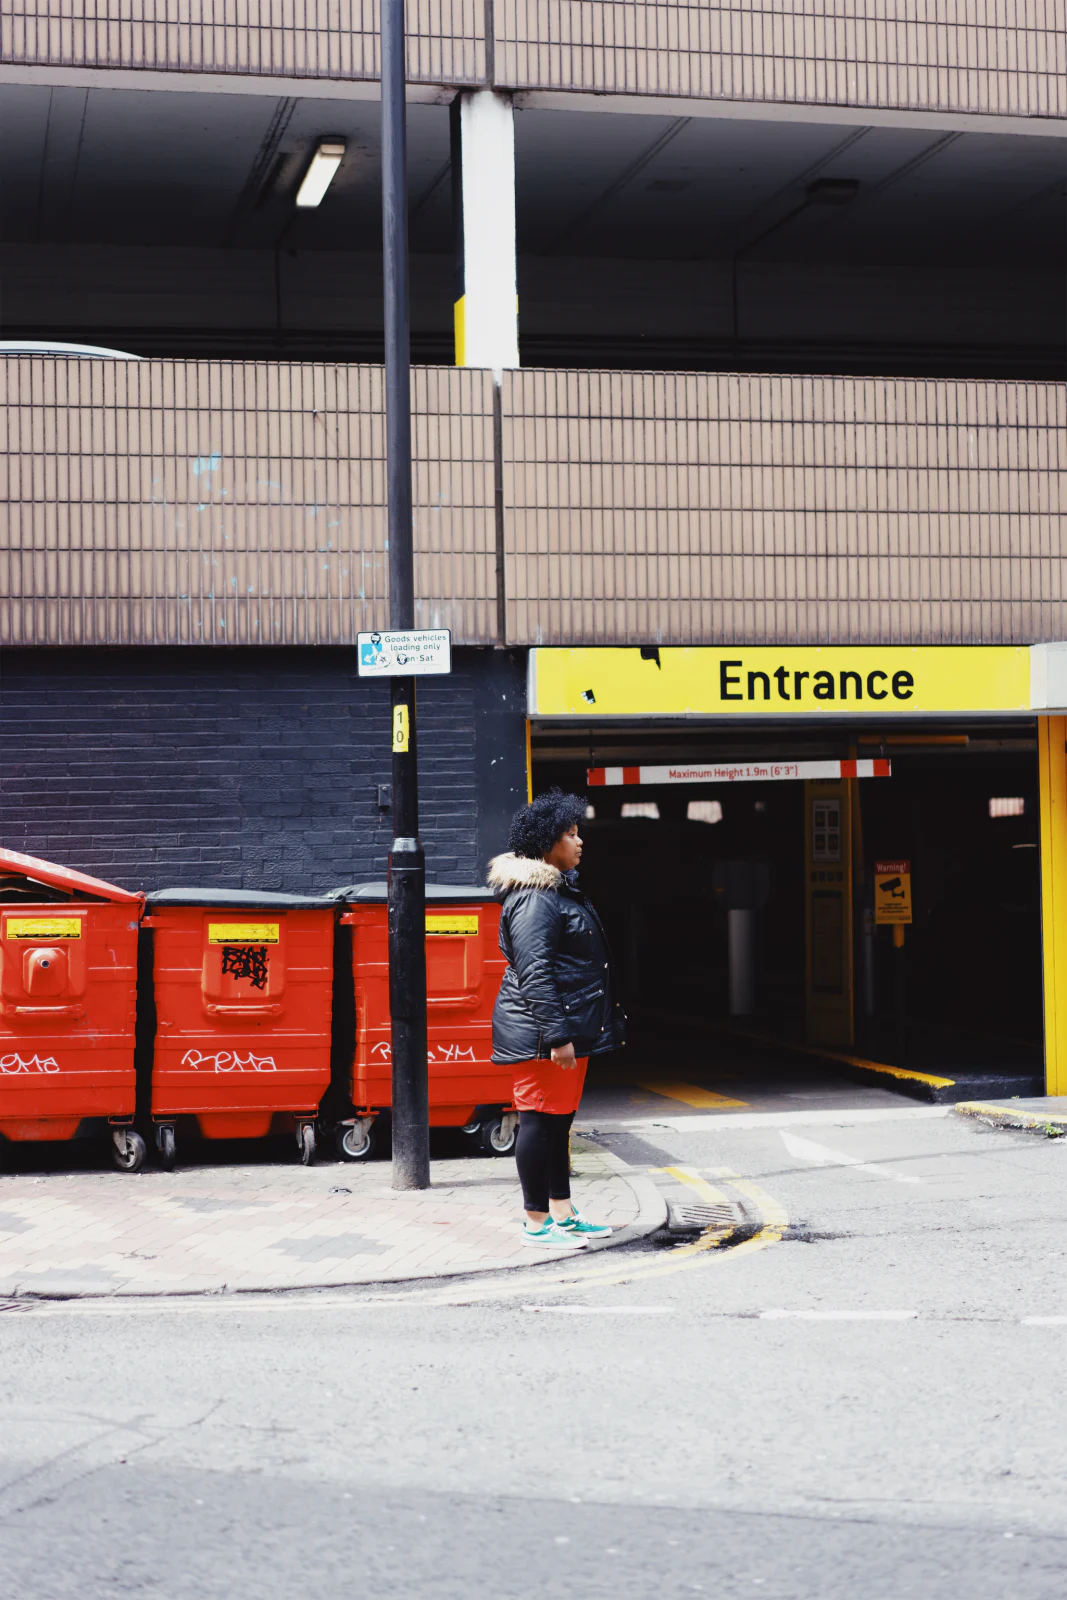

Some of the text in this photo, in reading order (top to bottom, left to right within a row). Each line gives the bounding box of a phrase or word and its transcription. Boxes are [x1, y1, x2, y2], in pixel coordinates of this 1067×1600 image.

[384, 633, 447, 643] Goods vehicles
[719, 660, 914, 700] Entrance
[668, 768, 713, 779] Maximum
[714, 767, 744, 780] Height
[746, 767, 768, 777] 1.9m
[876, 862, 907, 874] Warning!
